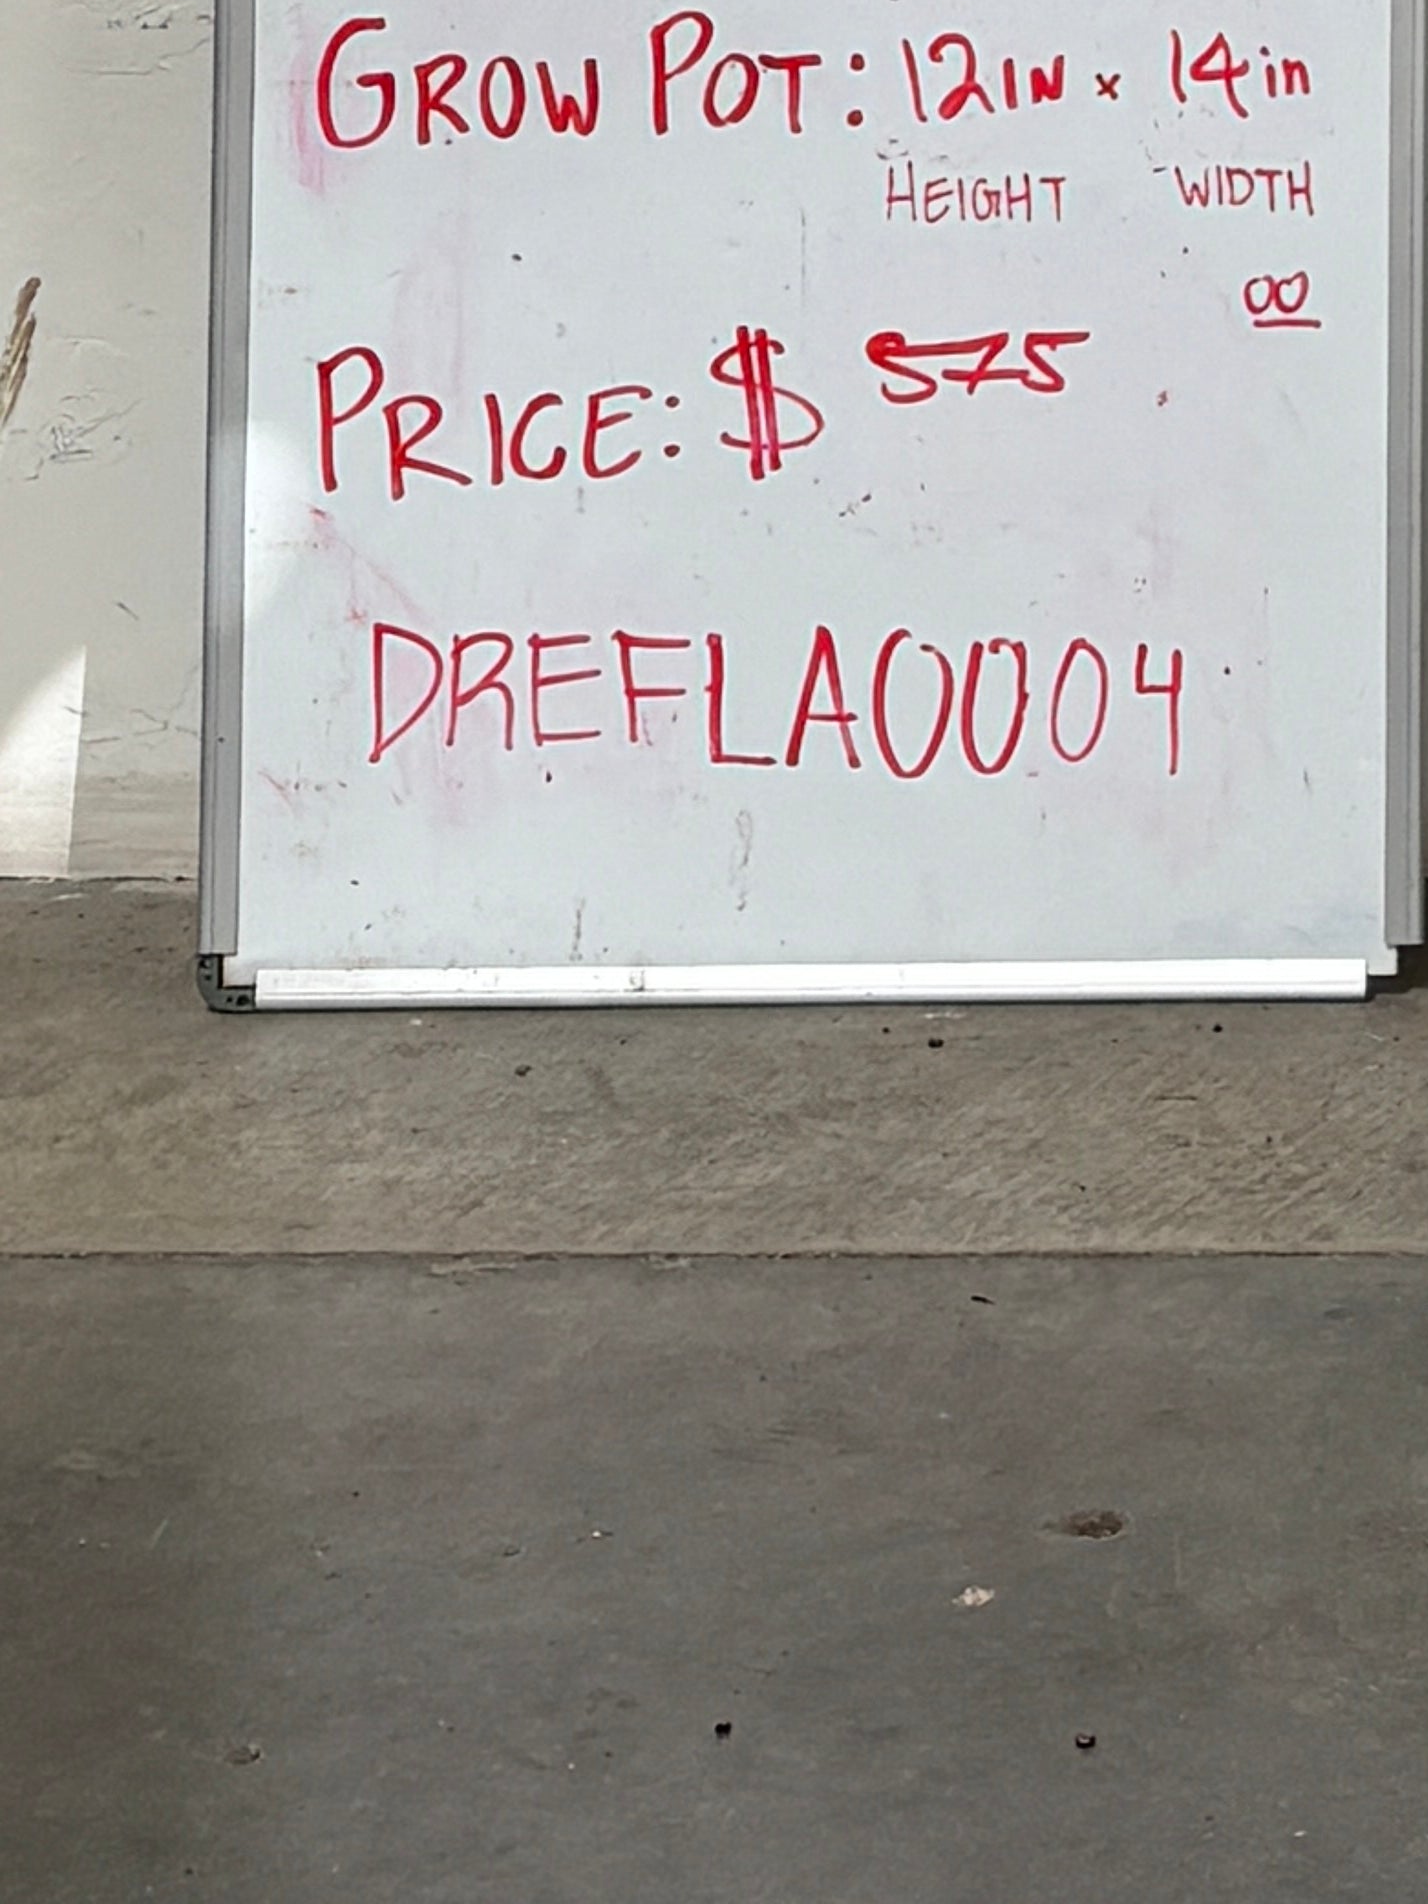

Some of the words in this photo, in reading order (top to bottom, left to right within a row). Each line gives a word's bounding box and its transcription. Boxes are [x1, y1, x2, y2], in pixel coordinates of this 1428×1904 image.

[314, 16, 601, 150] GROW
[649, 10, 864, 136] POT:
[886, 160, 1066, 224] HEIGHT
[1174, 160, 1315, 217] WIDTH
[316, 346, 682, 499] PRICE:
